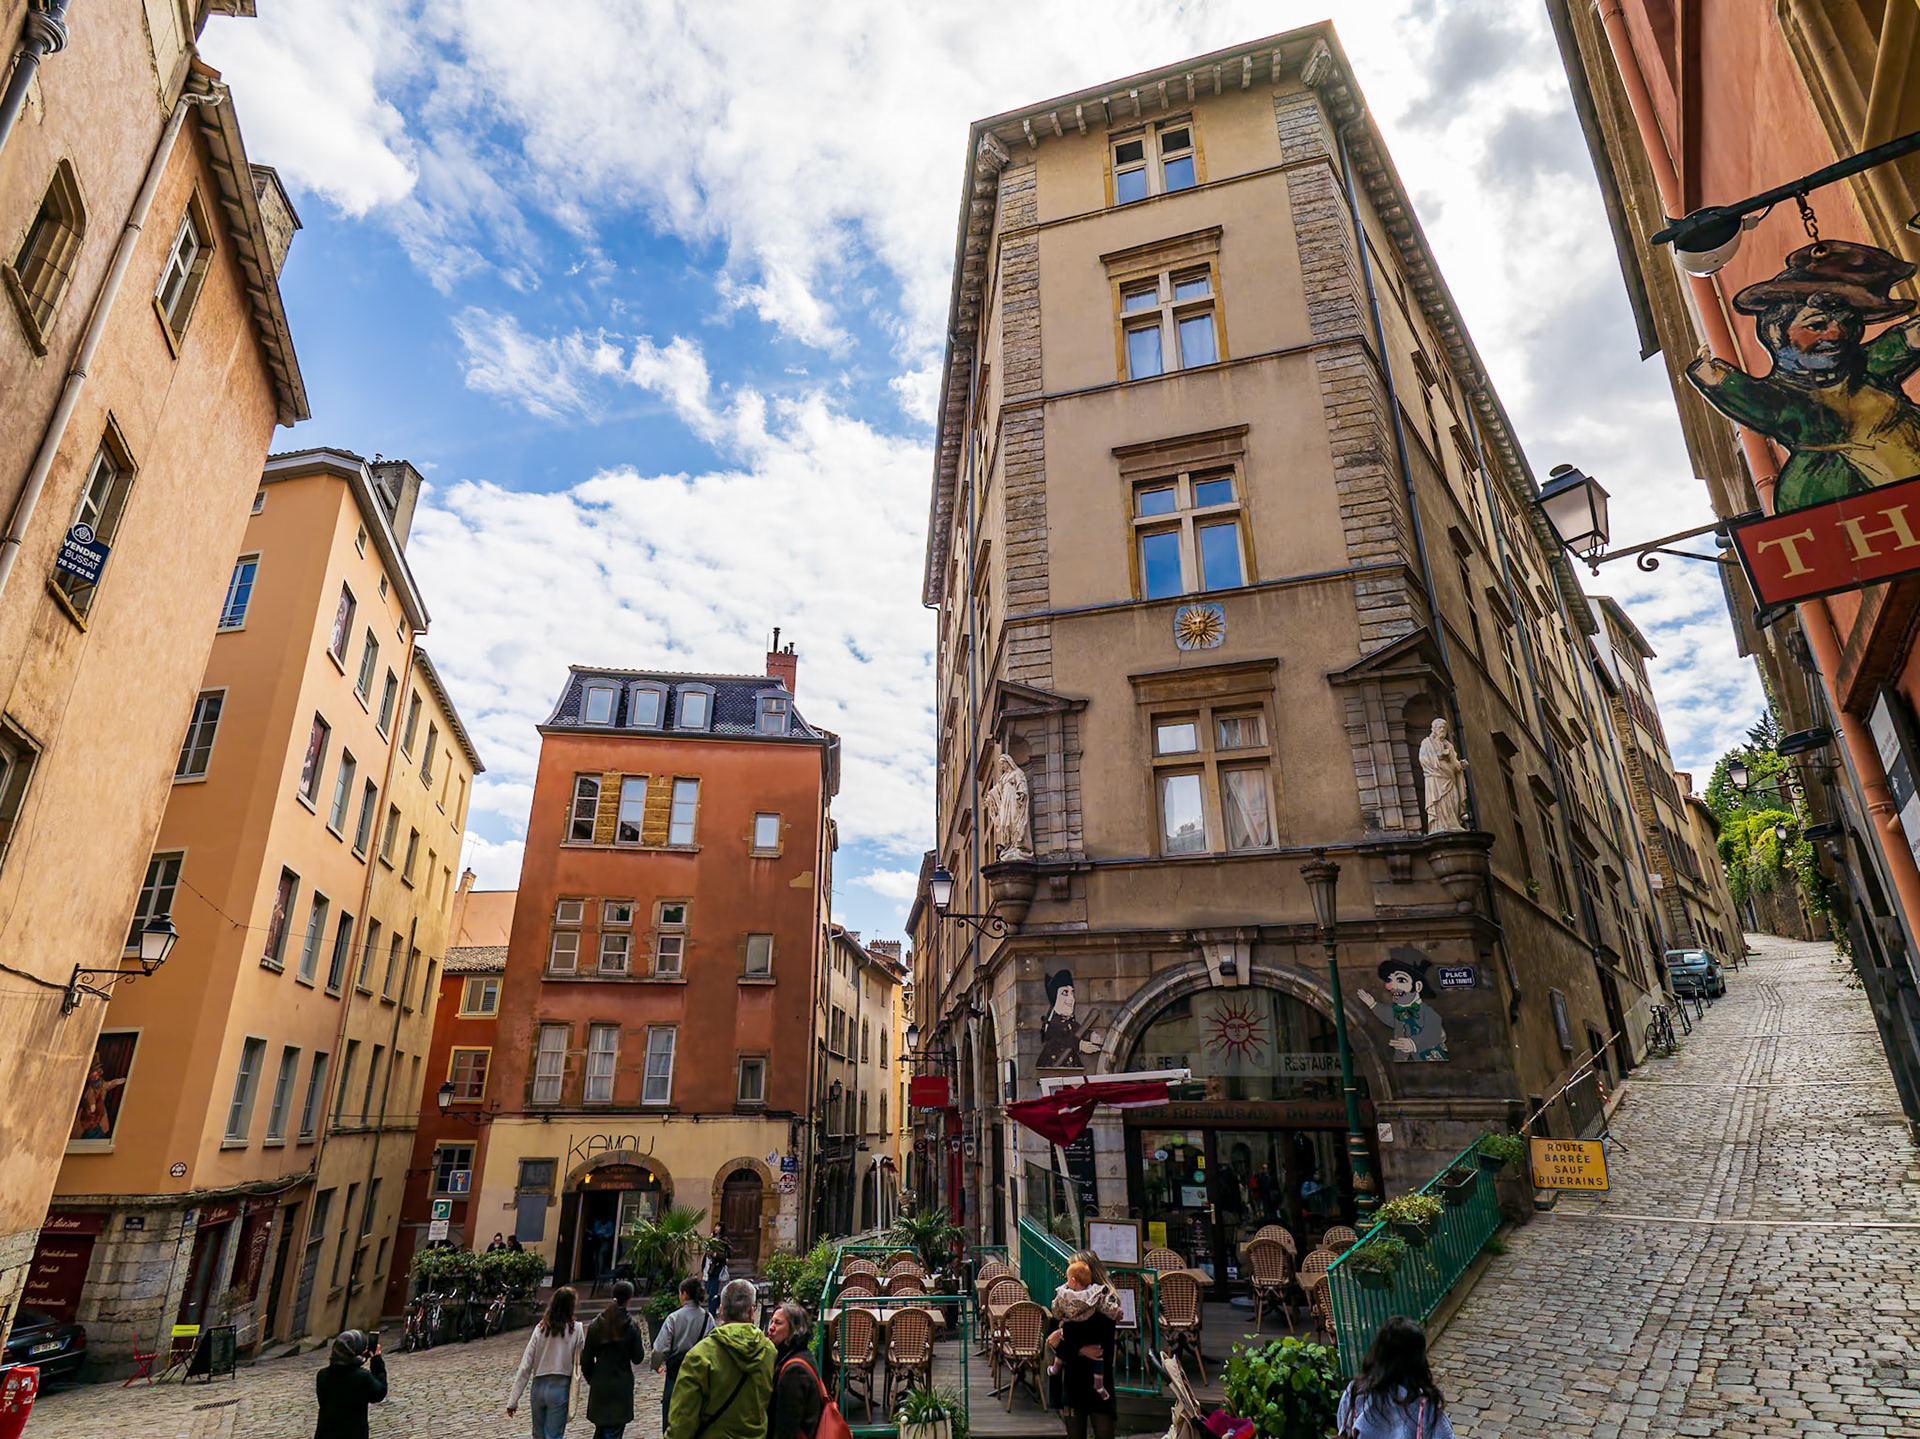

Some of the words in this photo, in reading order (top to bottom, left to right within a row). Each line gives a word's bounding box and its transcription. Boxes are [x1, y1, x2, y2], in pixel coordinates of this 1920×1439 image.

[64, 539, 102, 563] VENDRE
[65, 549, 99, 570] BUSSAT
[67, 562, 77, 570] 37
[1285, 1056, 1343, 1072] RESTAURA
[1547, 1143, 1585, 1152] ROUTE
[1544, 1153, 1591, 1164] BARRÉE
[1554, 1165, 1584, 1174] SAUF
[1538, 1175, 1603, 1186] RIVERAINS
